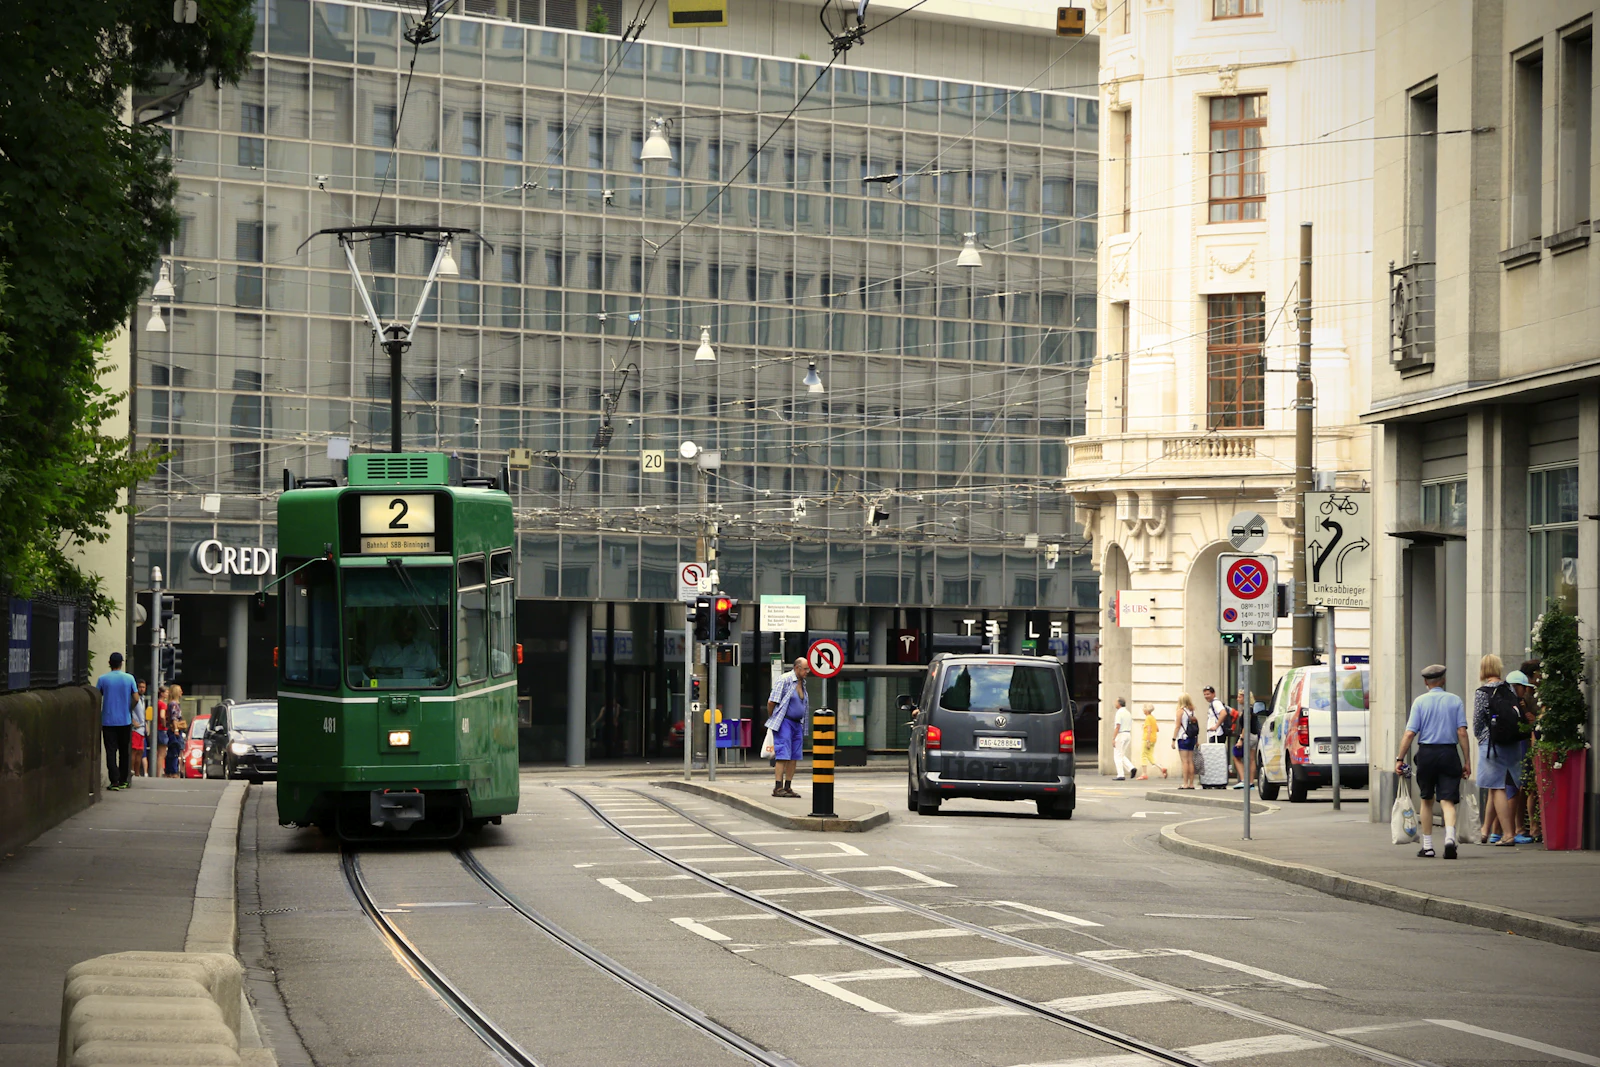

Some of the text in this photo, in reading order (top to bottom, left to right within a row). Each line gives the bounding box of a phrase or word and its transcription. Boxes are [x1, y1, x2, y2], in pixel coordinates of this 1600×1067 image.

[645, 455, 662, 468] 20
[389, 498, 408, 529] 2
[367, 541, 388, 549] Bahnhof
[1313, 584, 1366, 596] Linksabbieger
[1327, 596, 1364, 606] einordnen
[1132, 604, 1148, 613] UBS
[322, 717, 337, 734] 481
[461, 717, 470, 734] 481
